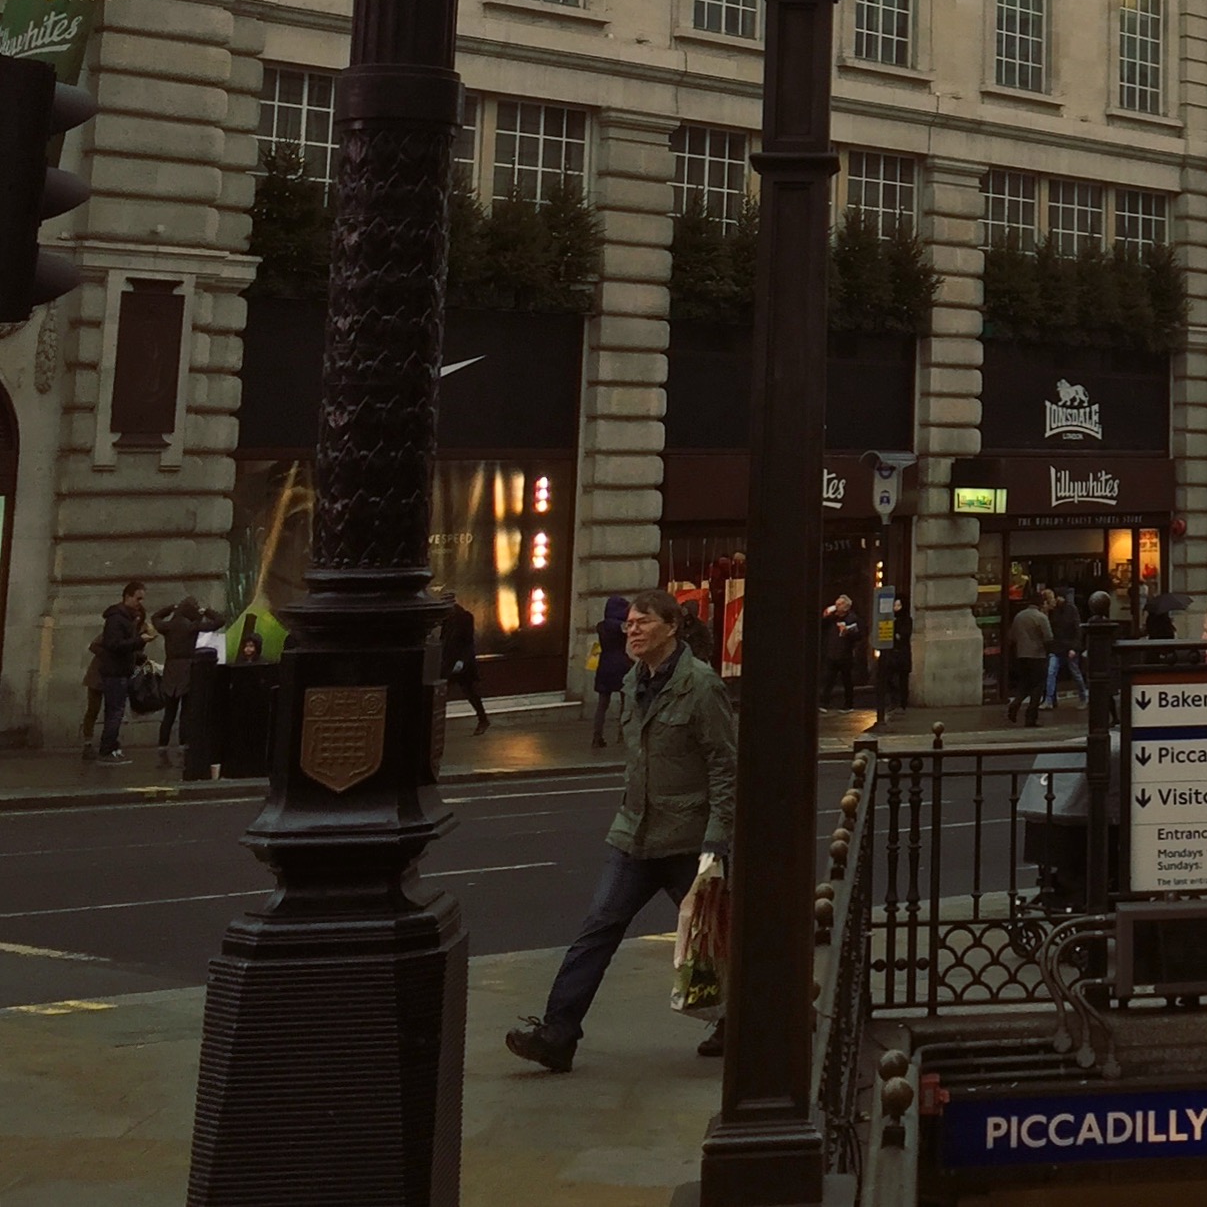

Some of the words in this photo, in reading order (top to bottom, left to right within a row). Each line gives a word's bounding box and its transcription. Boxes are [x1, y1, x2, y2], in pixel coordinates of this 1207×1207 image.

[1045, 400, 1102, 440] LONSDALE
[1050, 465, 1120, 507] Lillywhites
[1157, 848, 1204, 860] Mondays
[1157, 878, 1171, 886] The
